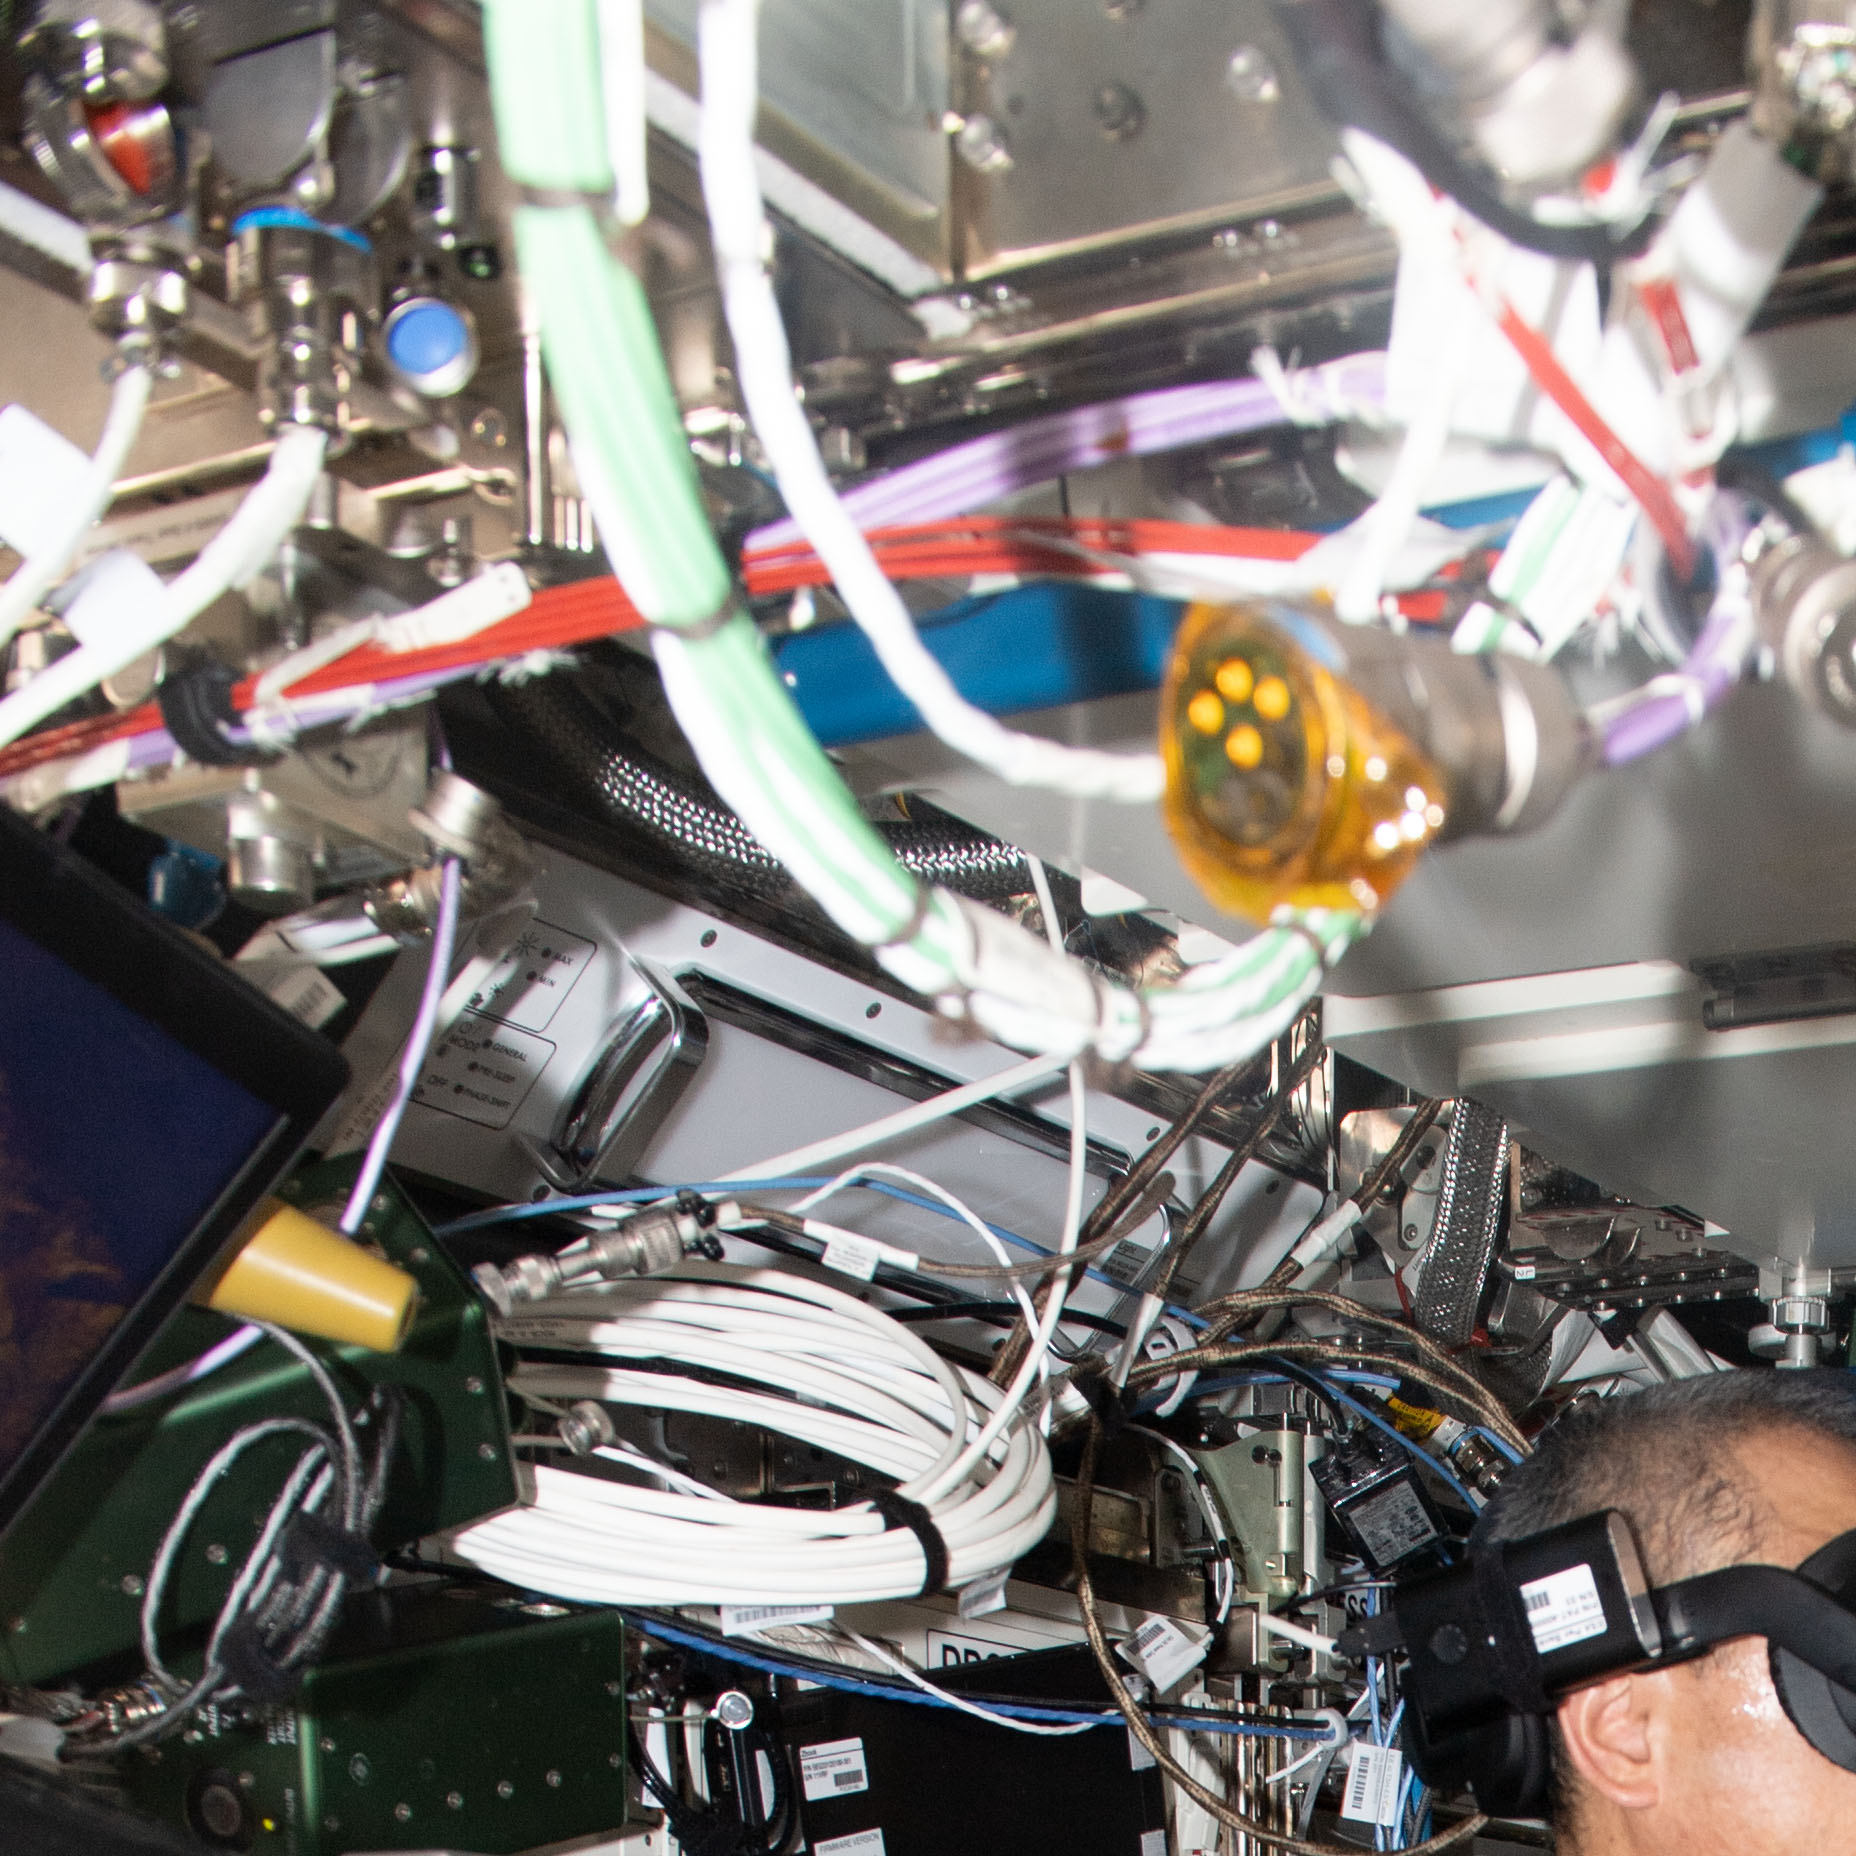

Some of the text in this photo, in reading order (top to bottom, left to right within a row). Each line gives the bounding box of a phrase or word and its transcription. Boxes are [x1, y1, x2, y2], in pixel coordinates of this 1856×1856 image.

[492, 1041, 528, 1062] GENERAL
[820, 1831, 880, 1853] FIRMWARE VERSION
